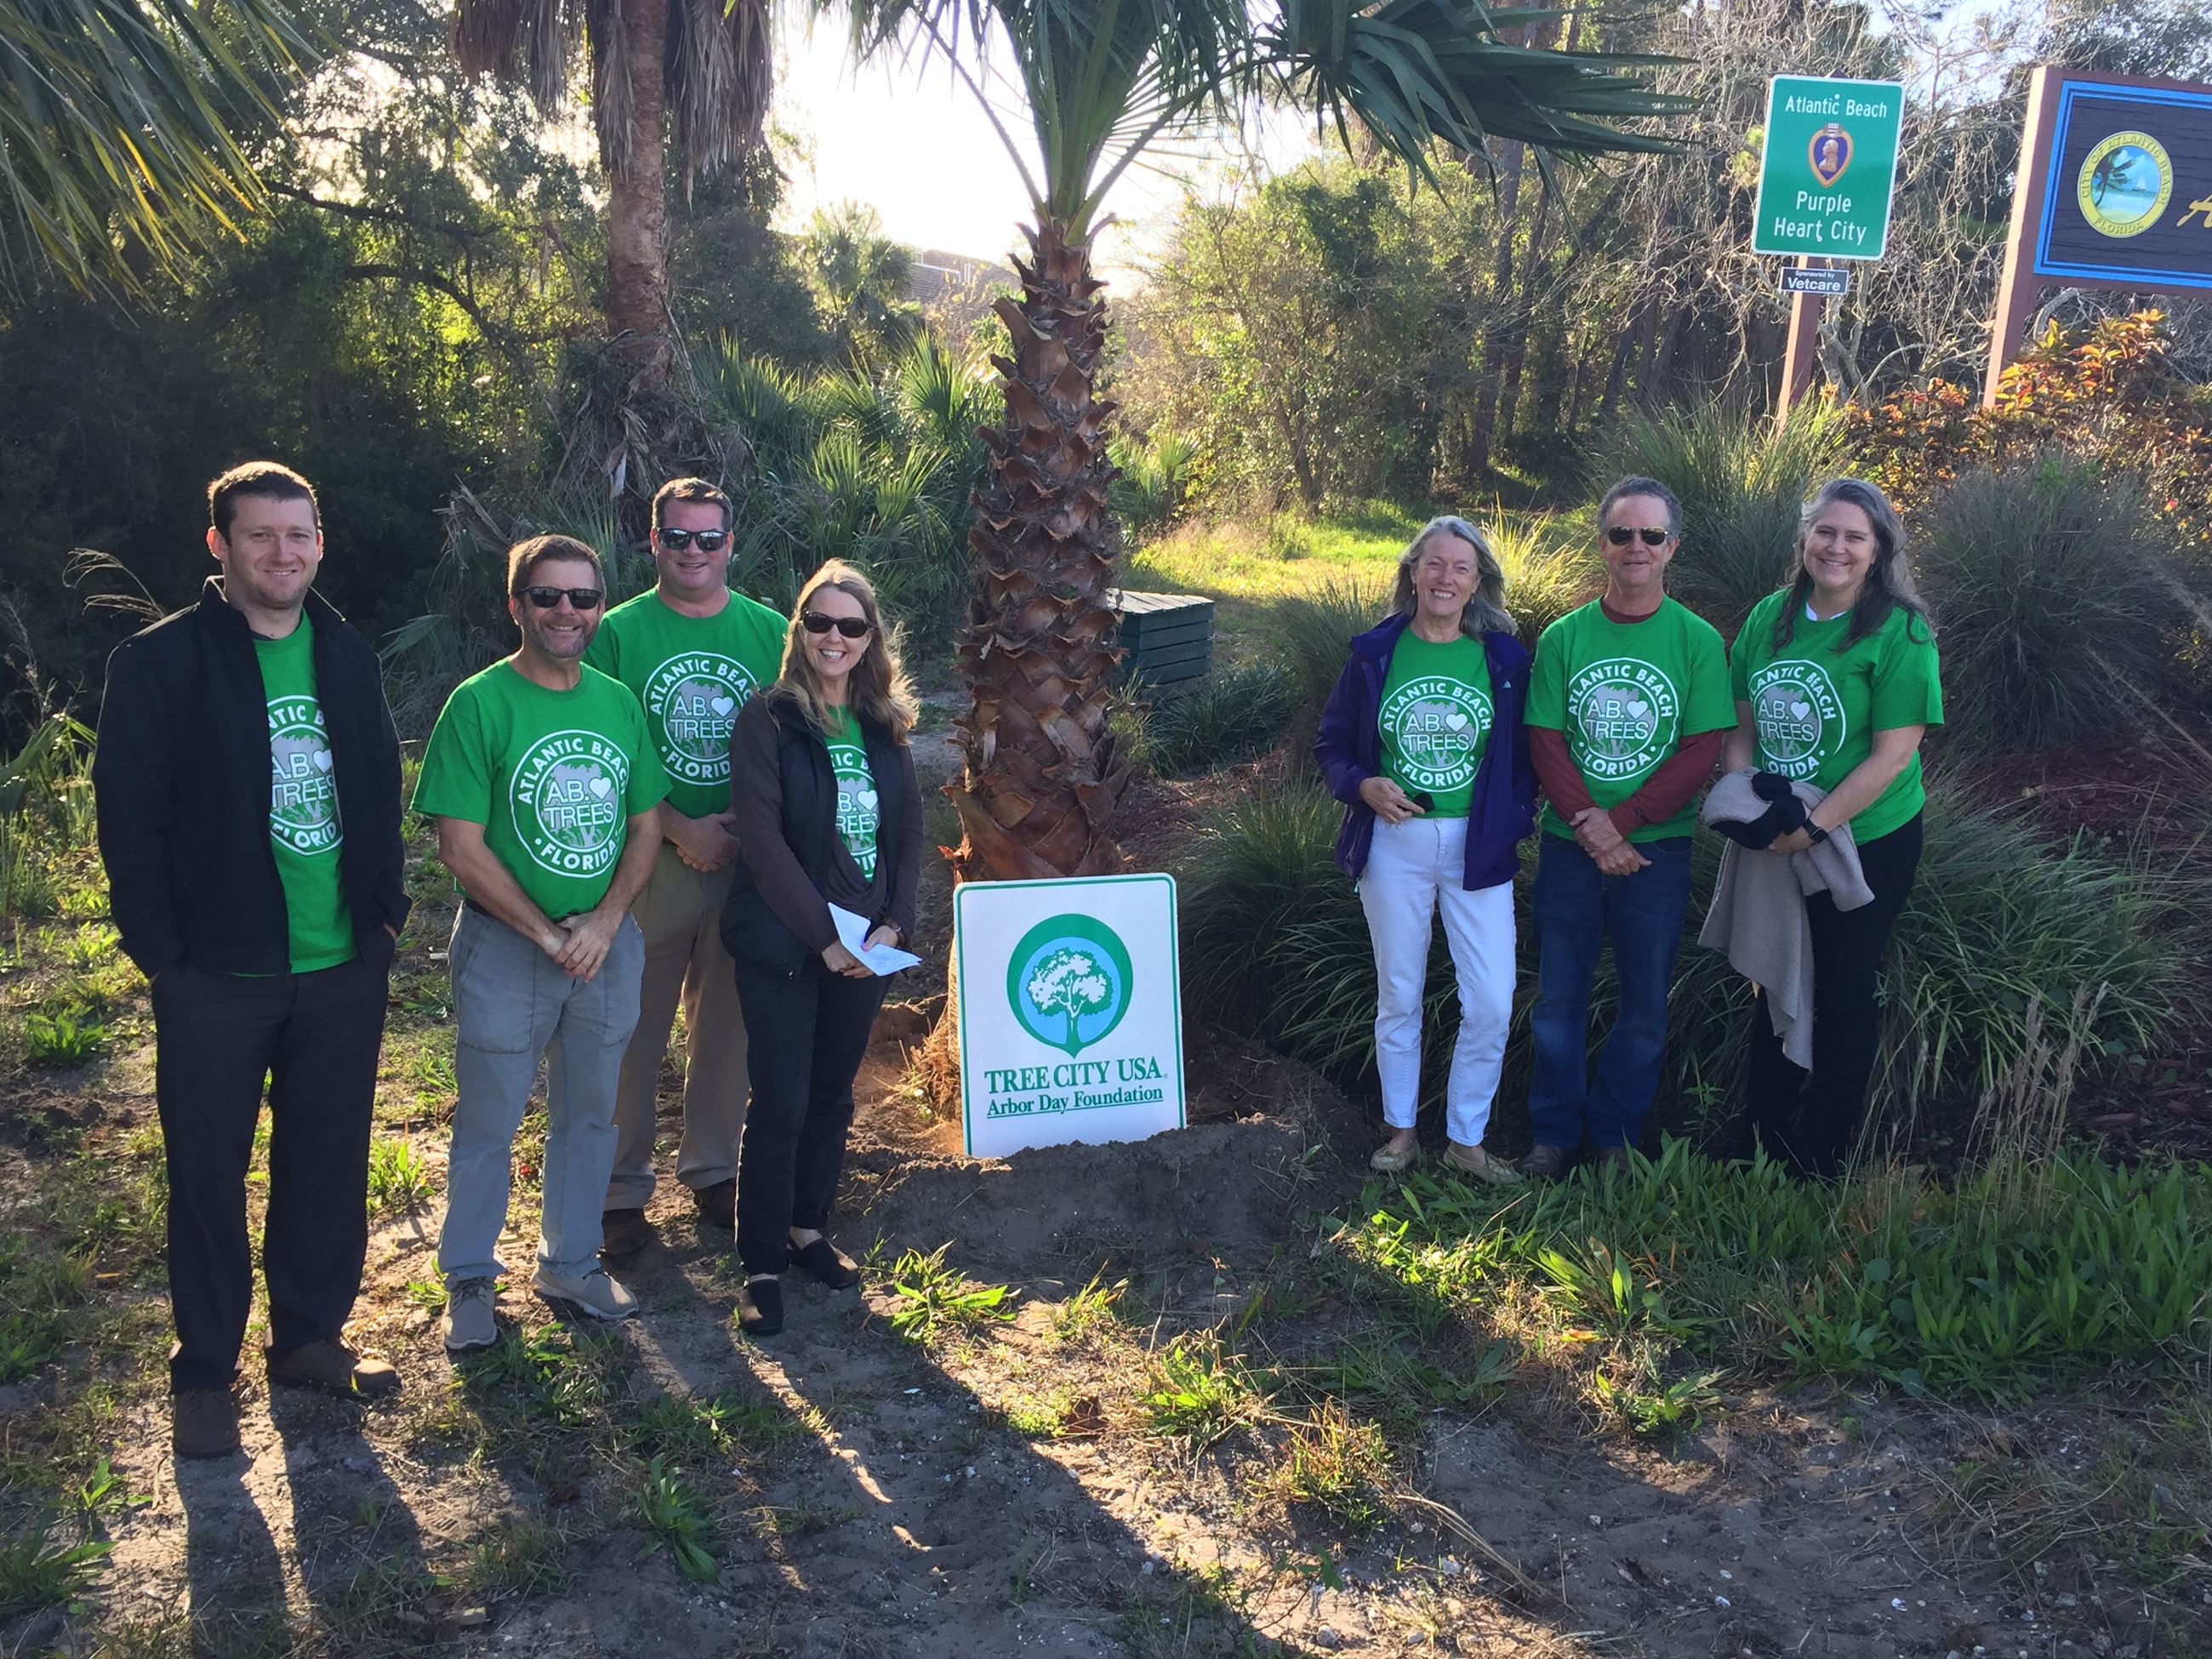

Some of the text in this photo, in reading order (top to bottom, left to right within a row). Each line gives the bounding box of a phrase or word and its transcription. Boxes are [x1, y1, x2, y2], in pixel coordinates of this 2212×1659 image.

[1784, 95, 1887, 118] Atlantic Beach
[2081, 134, 2170, 205] CITY OF ATLANTIC BEACH
[1796, 190, 1852, 216] Purple
[1773, 217, 1867, 246] Heart City
[2095, 217, 2144, 235] FLORIDA
[1787, 276, 1841, 291] Vetcare
[1795, 270, 1827, 278] Sponsored
[650, 658, 754, 715] ATLANTIC BEAC
[1568, 664, 1673, 718] ATLANTIC BEACH
[1751, 666, 1837, 720] LANTIC BEACH
[671, 696, 710, 716] A.B.
[1382, 682, 1491, 733] ATLANTIC BEACH
[1587, 698, 1625, 719] A.B.
[1758, 698, 1789, 721] A.B.
[1405, 713, 1445, 732] A.B.
[1584, 719, 1649, 740] TREES
[1757, 720, 1816, 742] TREES
[1402, 733, 1469, 751] TREES
[517, 738, 584, 805] ATLANTIC
[665, 750, 732, 778] FLORID
[1401, 761, 1474, 787] FLORIDA
[1764, 755, 1821, 778] ORIDA
[545, 780, 590, 805] A.B.
[543, 801, 614, 829] TREES
[540, 839, 617, 871] FLORIDA
[984, 1055, 1163, 1095] TREE CITY USA
[987, 1086, 1163, 1116] Arbor Day Foundation
